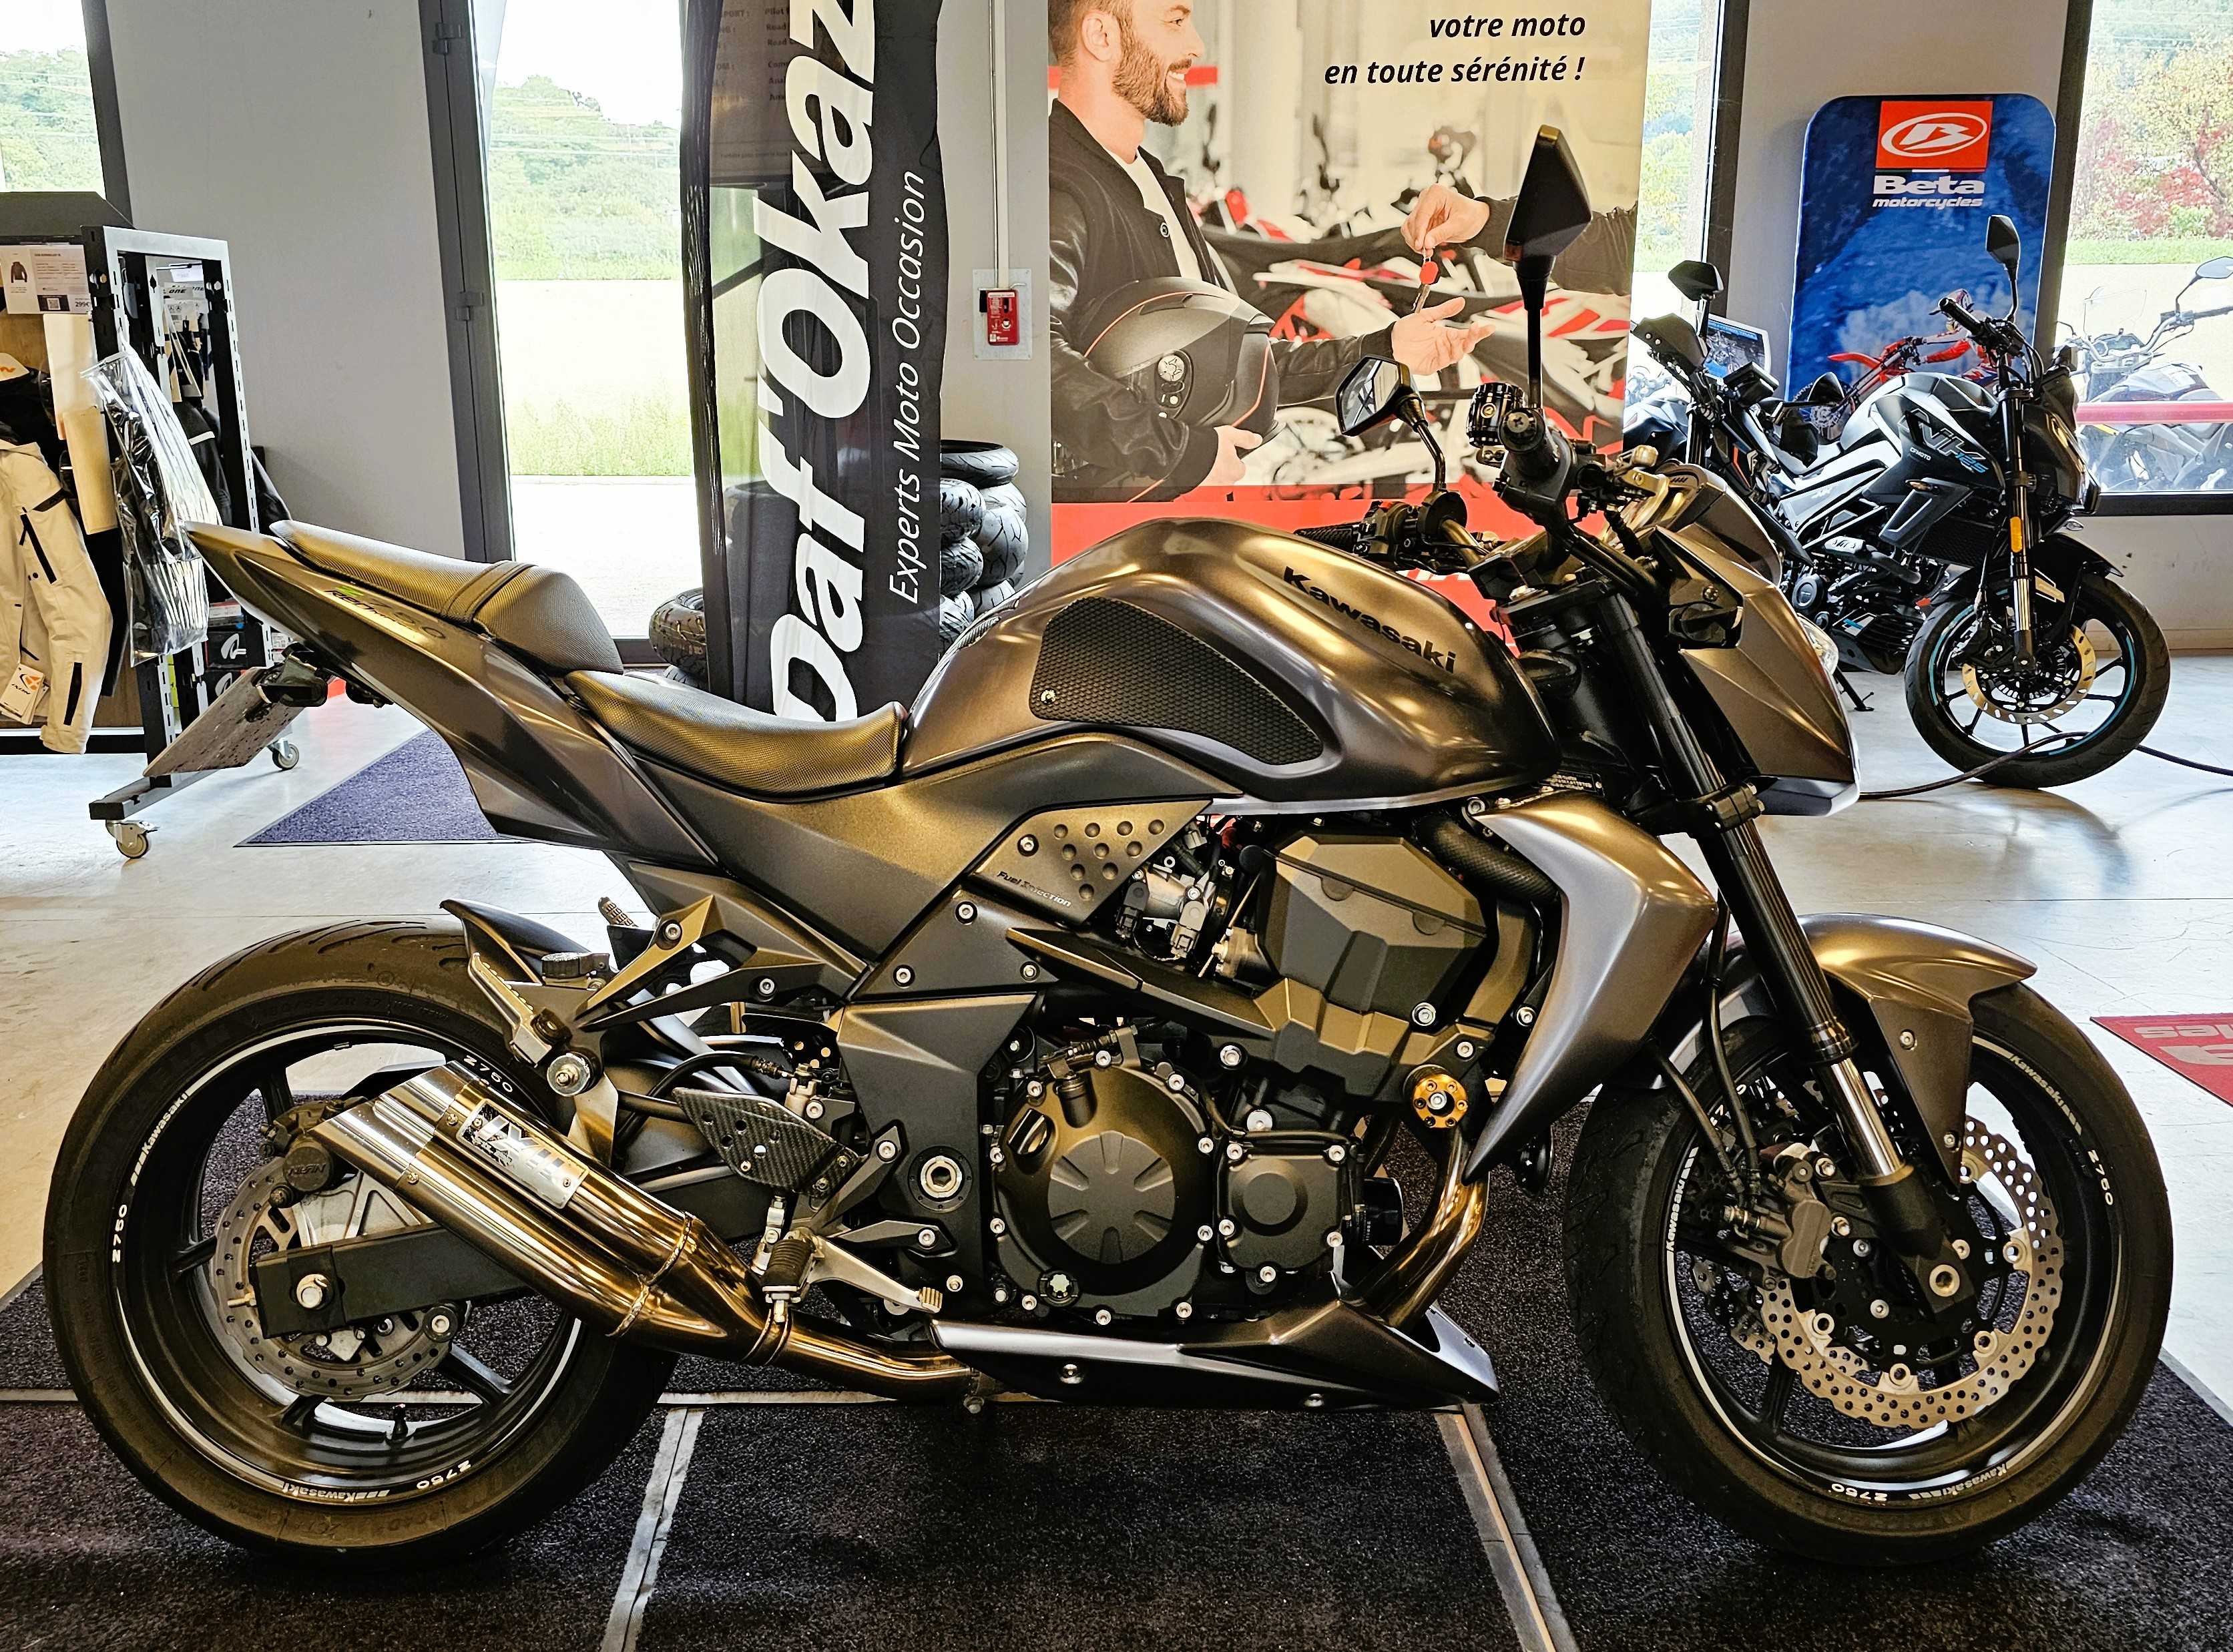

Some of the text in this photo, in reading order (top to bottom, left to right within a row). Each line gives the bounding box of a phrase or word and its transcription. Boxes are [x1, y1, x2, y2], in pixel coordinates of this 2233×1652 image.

[1429, 13, 1586, 38] votre moto
[1324, 63, 1358, 84] en
[1367, 60, 1443, 83] toute
[1451, 55, 1567, 82] sérénité
[1873, 175, 1985, 195] Beta
[1872, 196, 1984, 211] motorcycles
[889, 170, 928, 604] Experts Moto Occasion
[1909, 447, 1932, 461] CFMOTO
[1955, 451, 1989, 473] 125
[1283, 565, 1457, 674] Kawasaki
[997, 871, 1072, 907] Fuel Injection
[463, 1055, 513, 1093] Z750
[2010, 1055, 2064, 1107] Kawasaki
[142, 1093, 188, 1155] Kawasaki
[2087, 1149, 2114, 1206] Z750
[1666, 1179, 1686, 1252] Kawasaki
[111, 1204, 128, 1263] Z750
[282, 1481, 357, 1502] Kawasaki
[416, 1460, 471, 1490] Z750
[1942, 1463, 2008, 1496] Kawasaki
[1831, 1483, 1888, 1502] Z750
